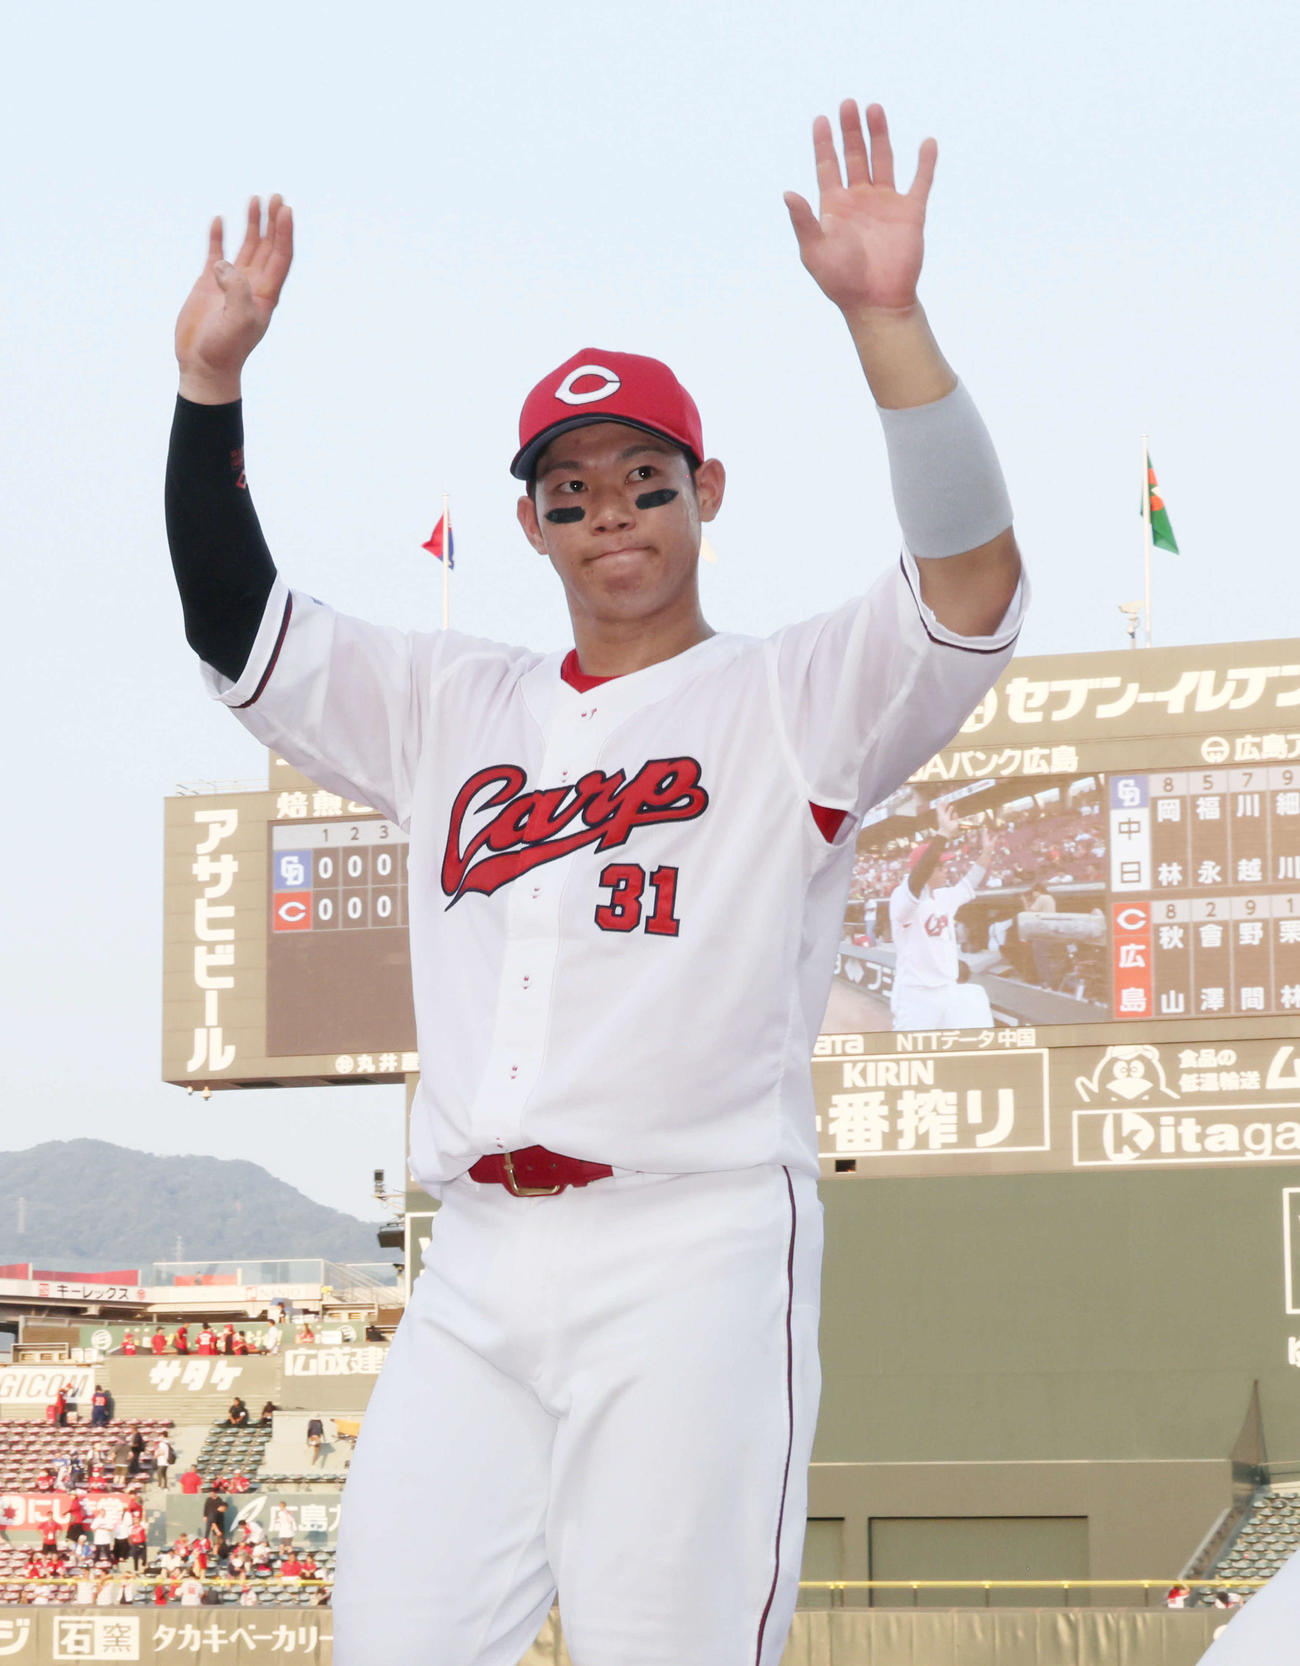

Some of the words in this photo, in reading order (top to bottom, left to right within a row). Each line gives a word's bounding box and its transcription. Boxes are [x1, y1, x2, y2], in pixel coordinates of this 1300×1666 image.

[1163, 777, 1174, 792] 8
[1203, 775, 1214, 790] 5
[1242, 772, 1253, 787] 7
[1282, 770, 1294, 785] 9
[318, 856, 333, 879] 0
[347, 855, 363, 878] 0
[376, 853, 392, 876] 0
[350, 826, 361, 841] 2
[379, 825, 389, 840] 3
[440, 756, 709, 912] Carp
[1118, 817, 1141, 884] 中日
[1157, 799, 1182, 886] 岡林
[1196, 796, 1222, 884] 福永
[1236, 793, 1263, 881] 川越
[318, 898, 333, 921] 0
[347, 896, 363, 919] 0
[376, 895, 392, 918] 0
[594, 863, 680, 937] 31
[1166, 904, 1176, 919] 8
[1206, 902, 1216, 917] 2
[1246, 900, 1256, 915] 9
[187, 809, 239, 1073] アサヒビール
[1159, 925, 1185, 1014] 秋山
[1239, 921, 1264, 1010] 野間
[1119, 943, 1147, 1012] 広島
[842, 1060, 935, 1088] KIRIN
[57, 1284, 129, 1300] キーレックス
[148, 1359, 243, 1392] サタケ
[284, 1347, 390, 1377] 広成建
